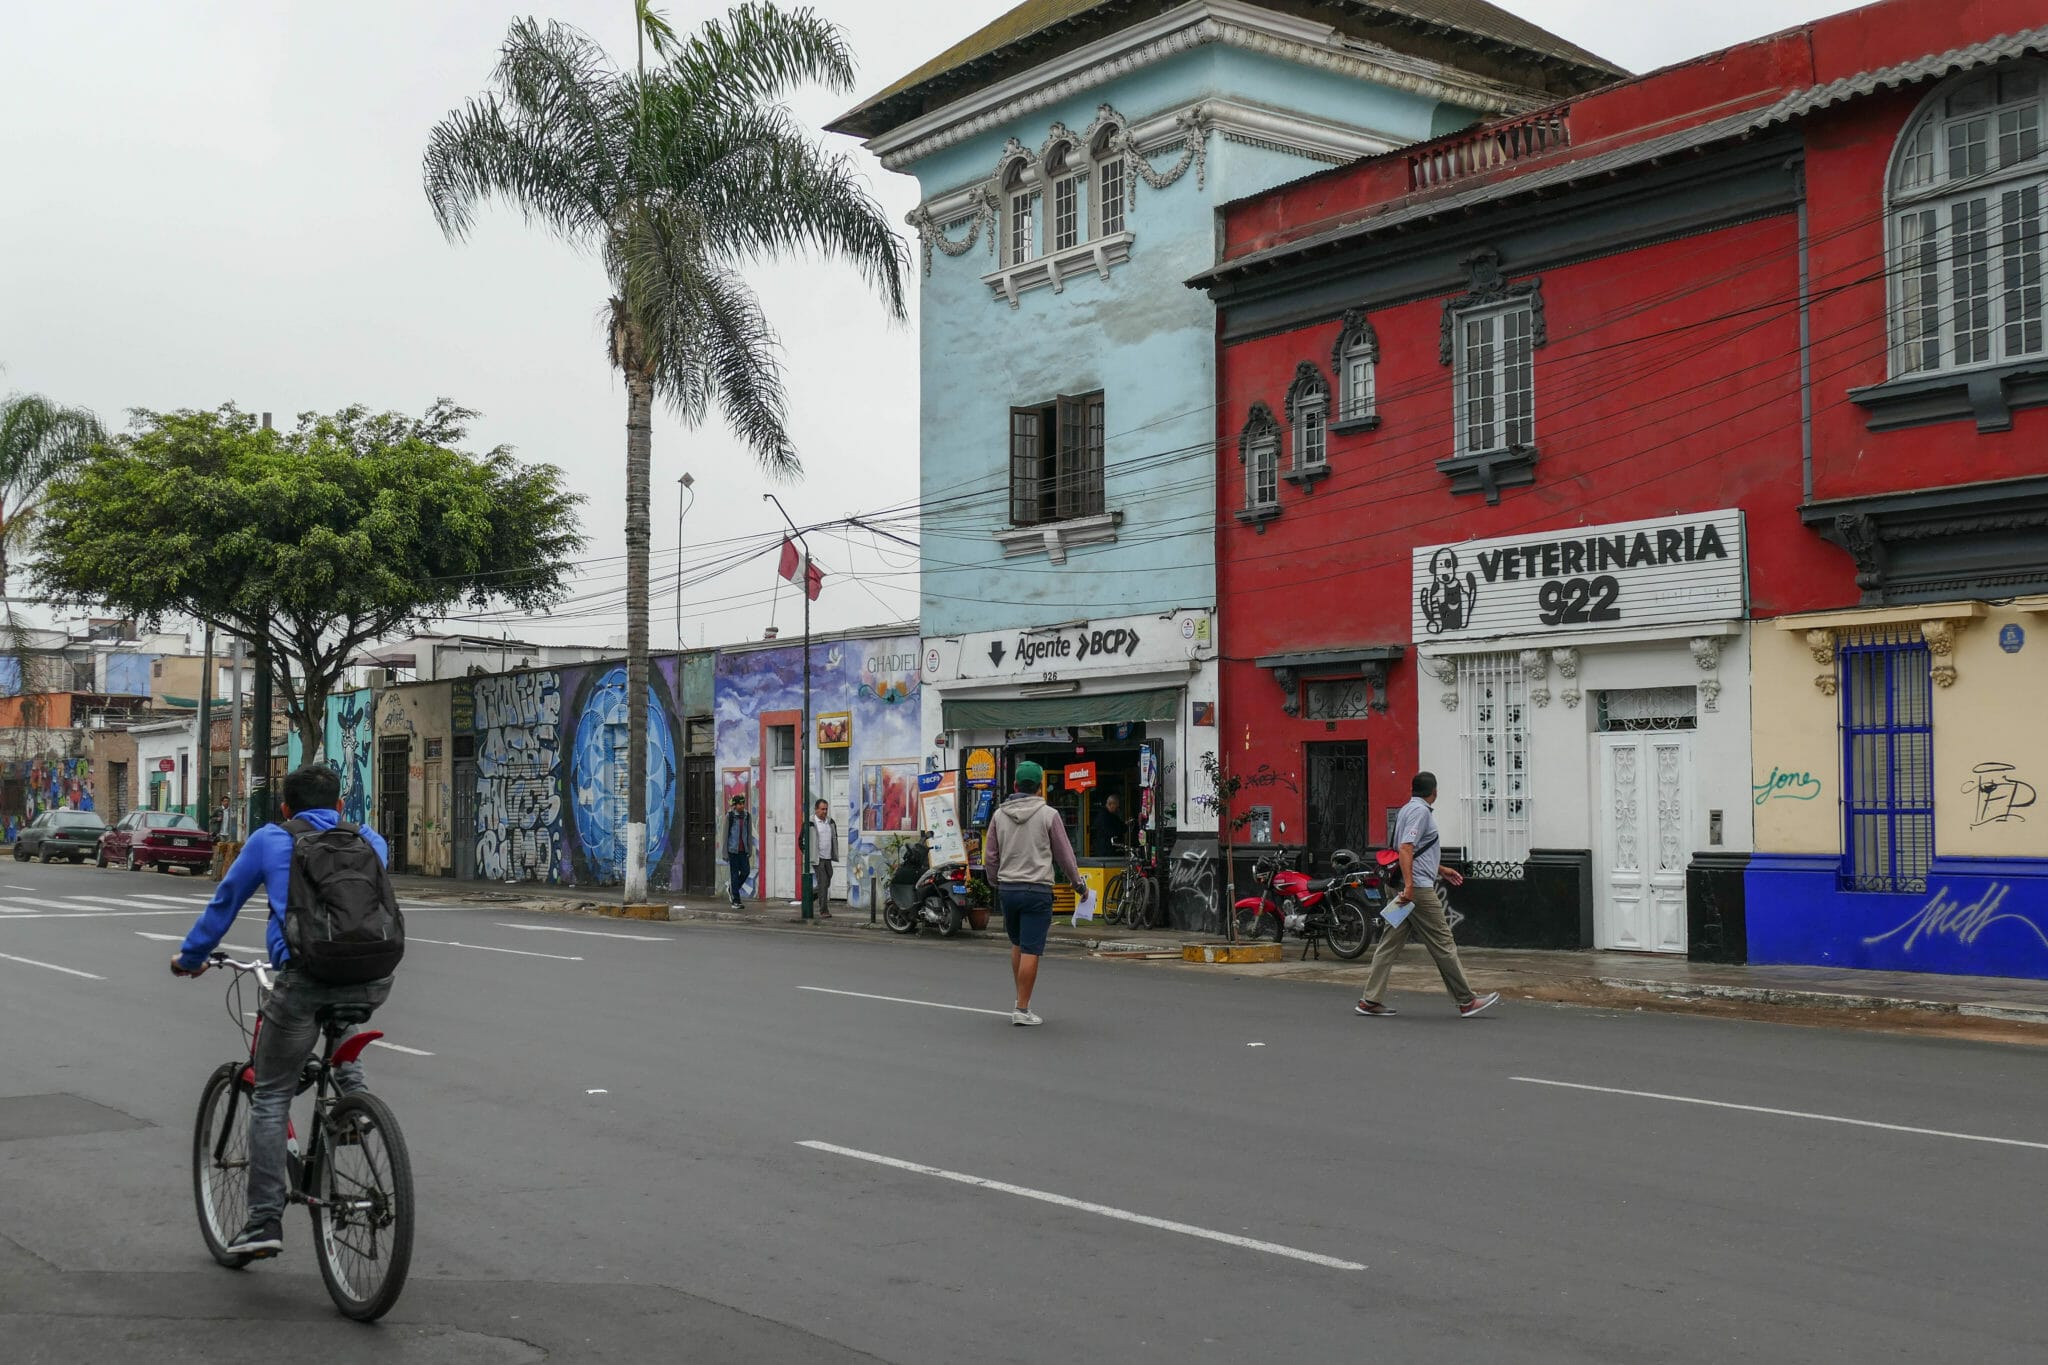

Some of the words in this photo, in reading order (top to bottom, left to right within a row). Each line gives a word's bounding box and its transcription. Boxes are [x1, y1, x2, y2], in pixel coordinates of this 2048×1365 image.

[1477, 524, 1728, 583] VETERINARIA
[1538, 575, 1621, 626] 922
[867, 653, 920, 674] GHADIEL
[1015, 636, 1071, 667] Agente
[1042, 671, 1058, 681] 926
